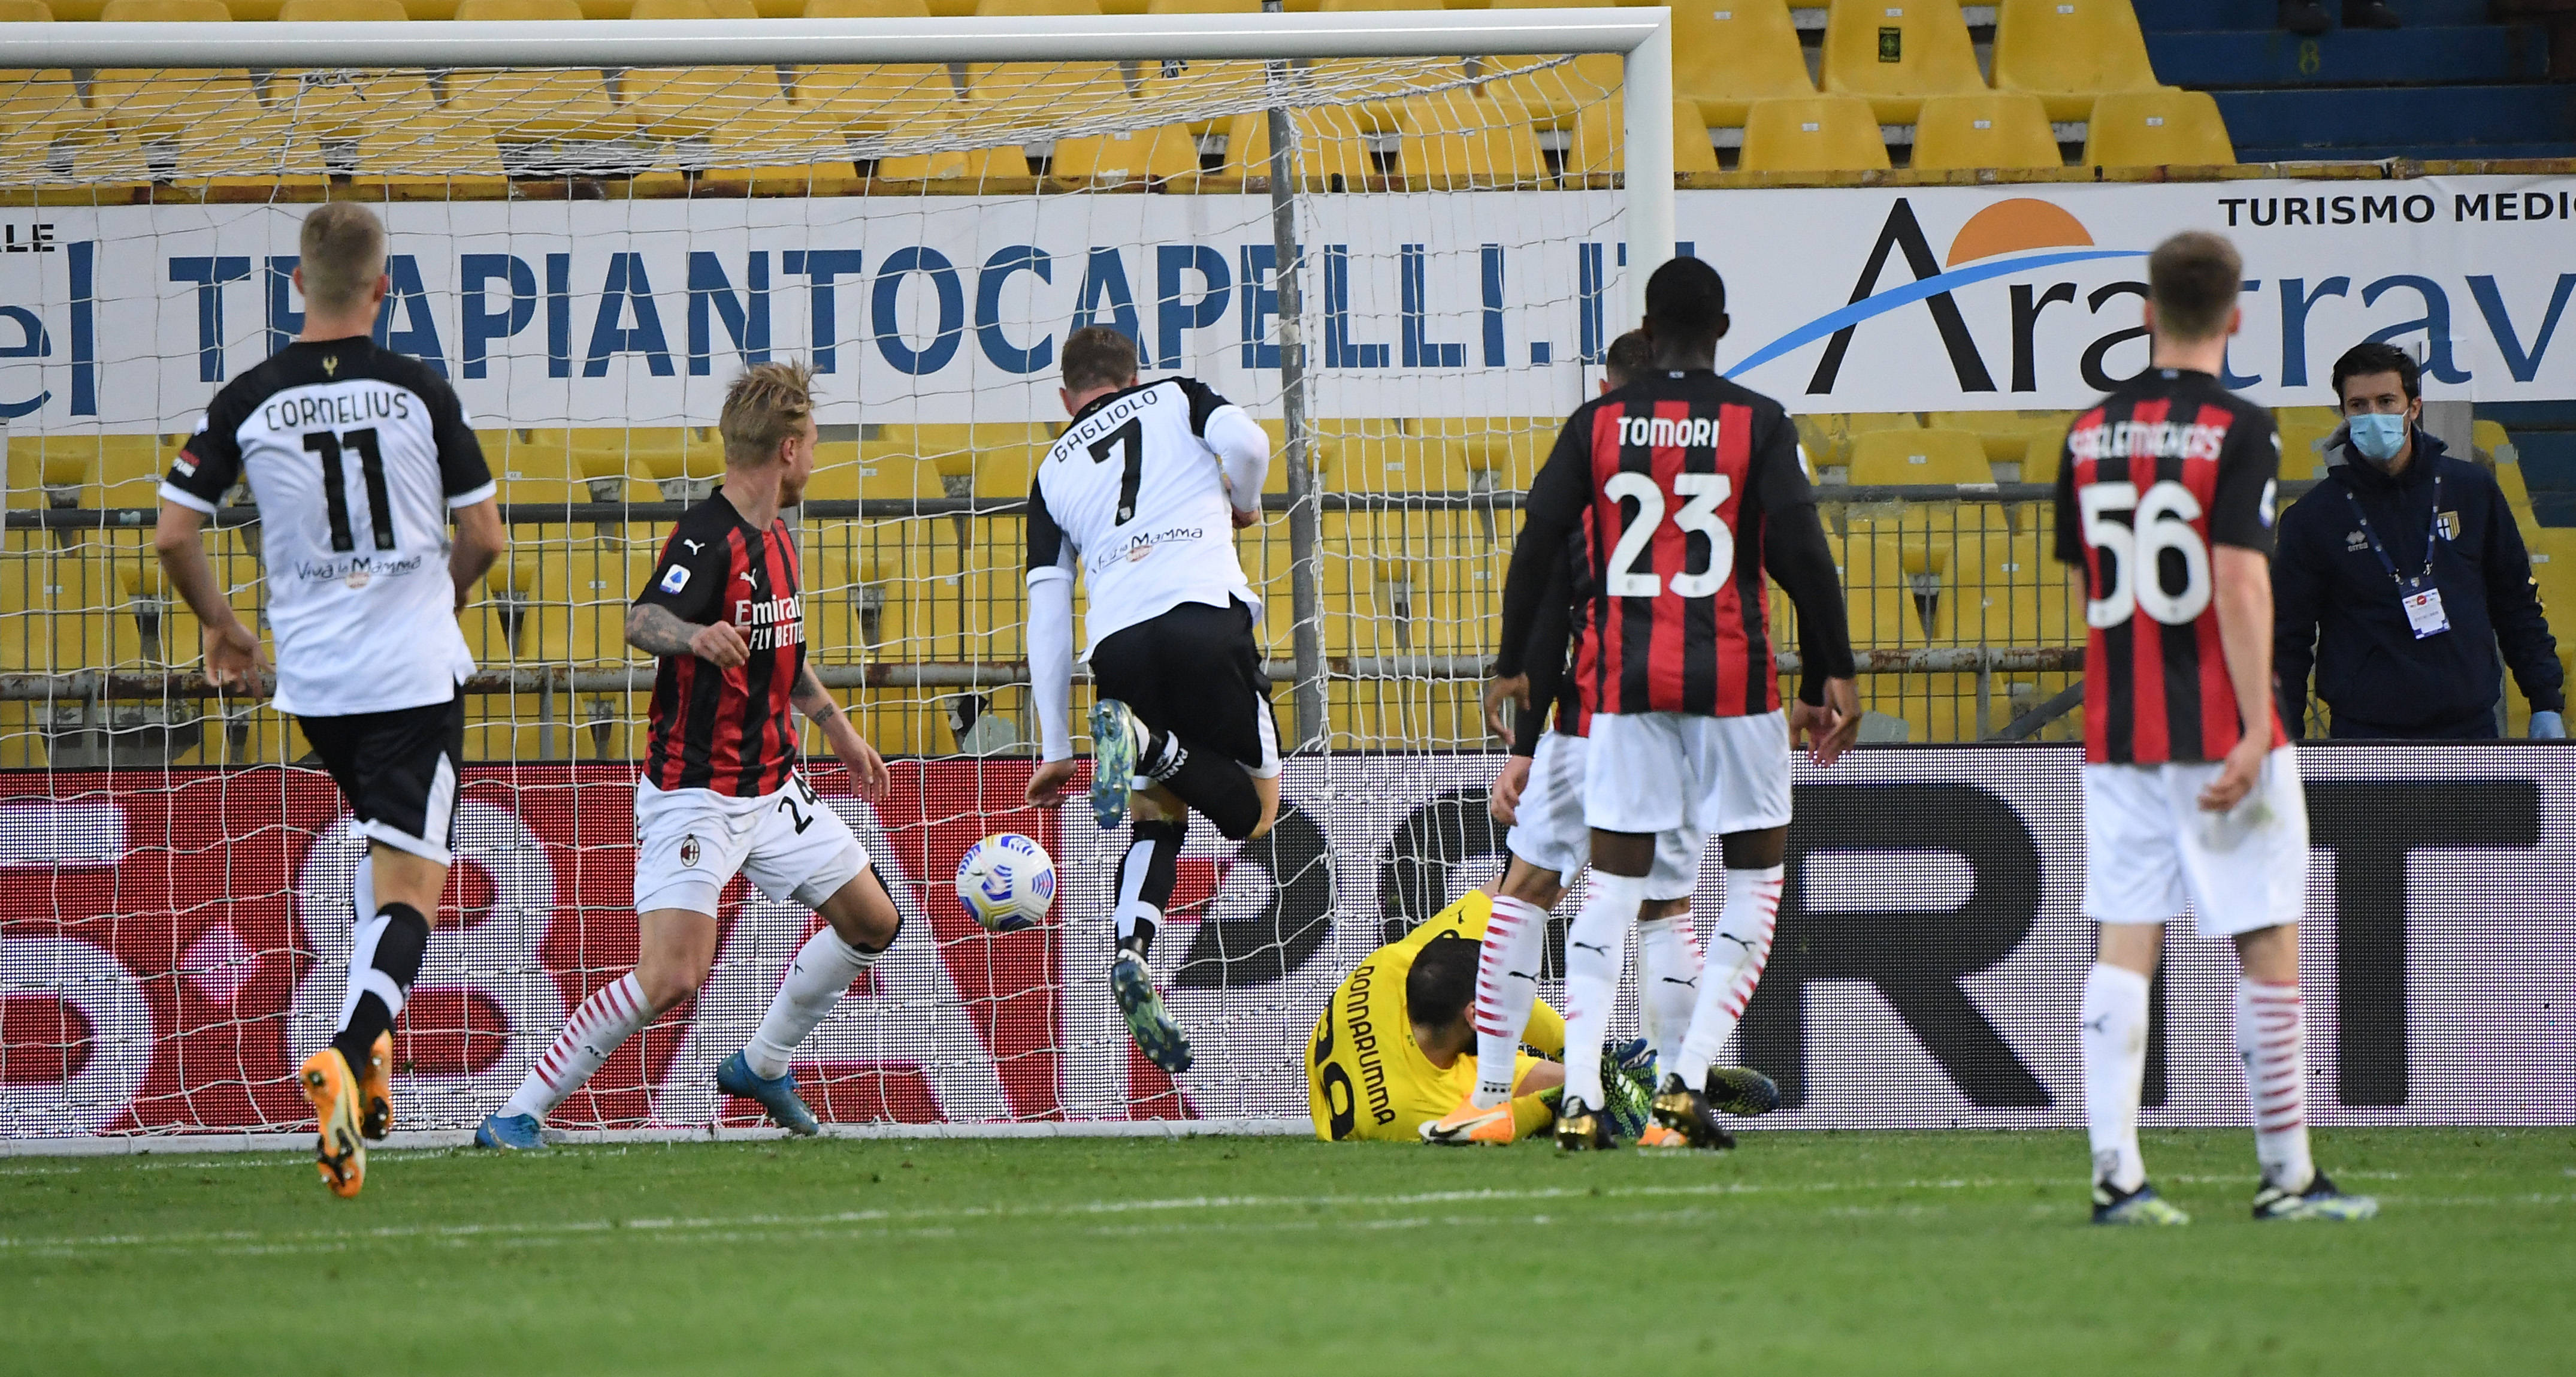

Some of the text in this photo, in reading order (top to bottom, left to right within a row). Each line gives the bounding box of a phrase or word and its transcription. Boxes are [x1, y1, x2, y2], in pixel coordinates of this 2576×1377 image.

[0, 224, 55, 253] LE
[2218, 191, 2576, 227] TURISMO MEDI
[169, 241, 1695, 382] TAPIANTOCAPELLI.I
[265, 391, 409, 431] CORNELIUS
[1054, 390, 1157, 463] GAGLIOLO
[1617, 416, 1720, 448] TOMORI
[303, 427, 396, 552] 11
[1087, 416, 1142, 527] 7
[1132, 528, 1203, 548] Mamma
[1604, 471, 1736, 598] 23
[2079, 481, 2212, 629] 56
[295, 560, 334, 579] Viva
[352, 555, 422, 574] Mamma
[749, 627, 772, 650] FLY
[778, 772, 823, 835] 24
[1347, 965, 1396, 1126] DONNARUMMA
